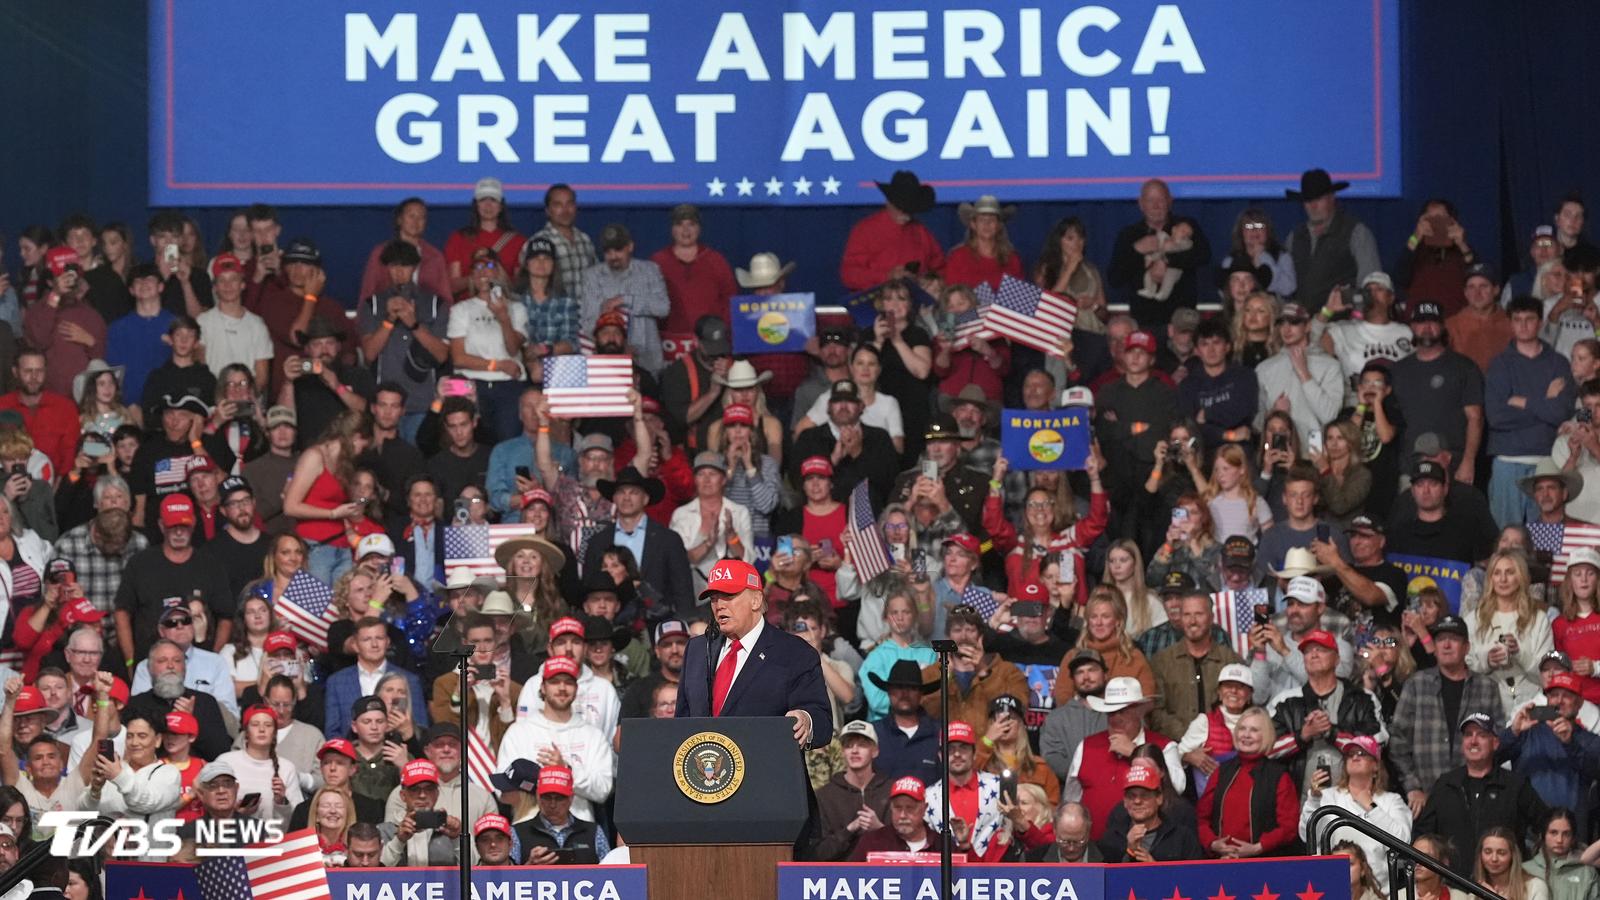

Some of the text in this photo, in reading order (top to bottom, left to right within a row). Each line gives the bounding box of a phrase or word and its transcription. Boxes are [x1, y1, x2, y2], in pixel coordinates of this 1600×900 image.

[345, 6, 1206, 82] MAKE AMERICA
[375, 87, 1171, 164] GREAT AGAIN!
[740, 302, 805, 312] MONTANA
[1011, 416, 1080, 429] MONTANA
[709, 568, 733, 584] USA
[676, 735, 706, 766] PRESIDENT
[727, 742, 743, 772] UNITED
[715, 777, 740, 800] STATES
[346, 882, 445, 900] MAKE
[803, 877, 1079, 900] MAKE AMERICA
